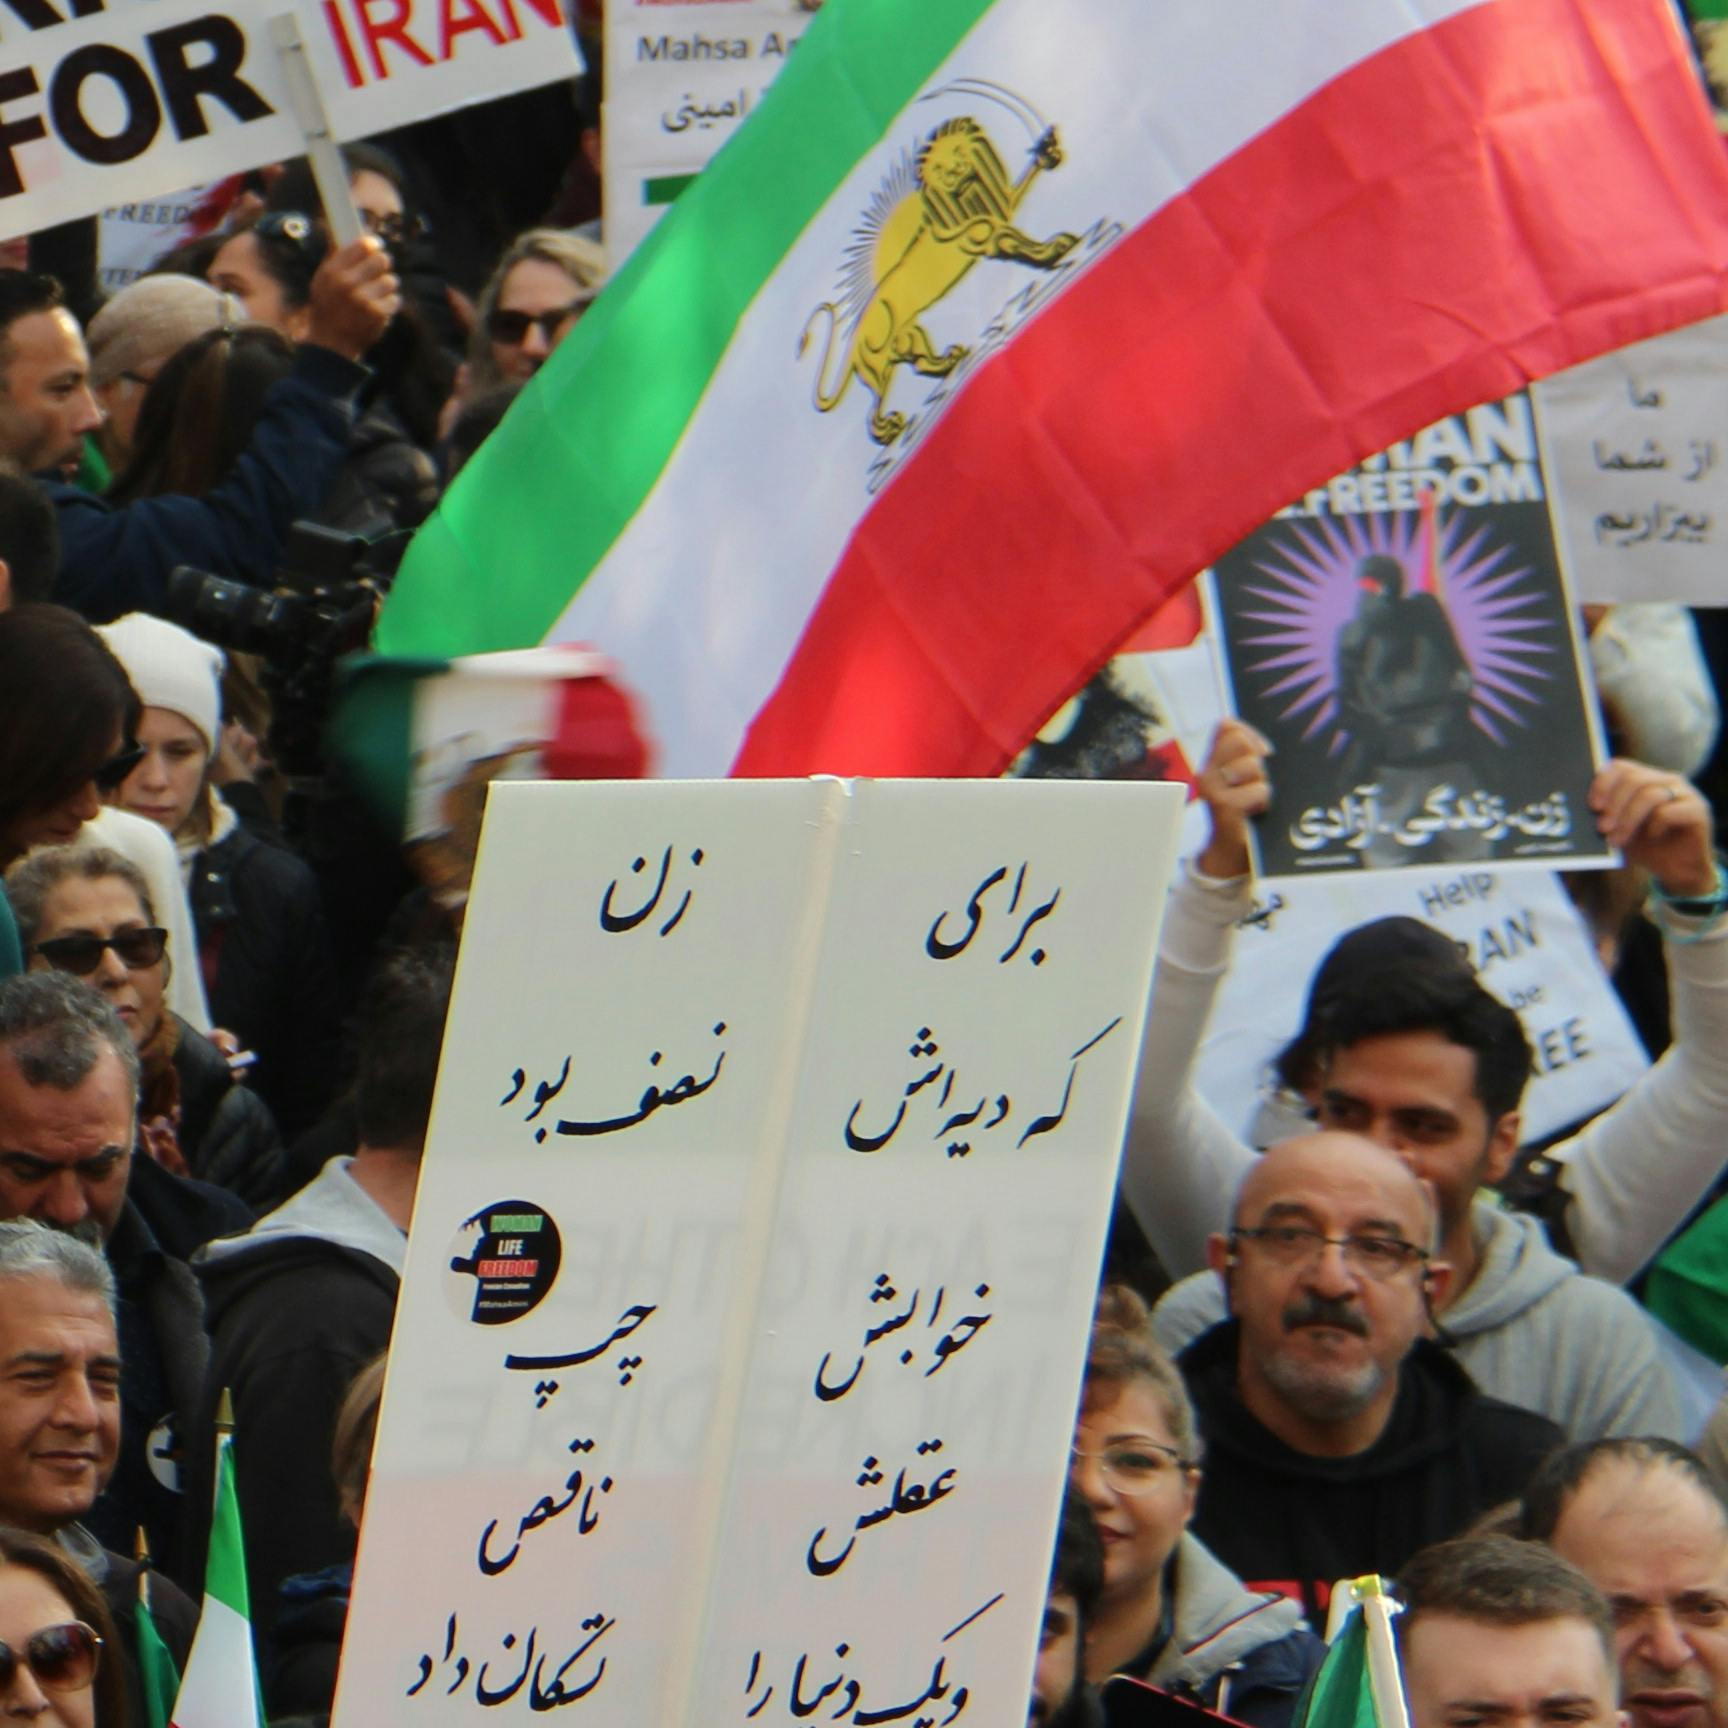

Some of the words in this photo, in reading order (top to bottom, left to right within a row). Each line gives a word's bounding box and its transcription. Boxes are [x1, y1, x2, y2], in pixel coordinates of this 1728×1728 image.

[637, 33, 750, 63] Mahsa
[661, 87, 748, 134] امینی
[1626, 375, 1662, 410] ما
[1591, 438, 1667, 471] شما
[1682, 438, 1718, 483] از
[600, 844, 705, 938] زن
[925, 858, 1064, 967] برای
[1417, 872, 1497, 918] Help
[1508, 982, 1544, 1012] be
[500, 1052, 575, 1144] بود
[553, 1020, 730, 1136] نصف
[1017, 1016, 1124, 1150] که
[477, 1259, 539, 1278] FREEDOM
[497, 1239, 524, 1255] LIFE
[503, 1299, 659, 1410] چپ
[814, 1272, 992, 1403] خوابش
[478, 1439, 615, 1577] ناقص
[806, 1439, 958, 1579] عقلش
[405, 1611, 471, 1697] داد
[476, 1613, 616, 1713] تکان
[745, 1649, 775, 1719] را
[789, 1643, 859, 1722] دنیا
